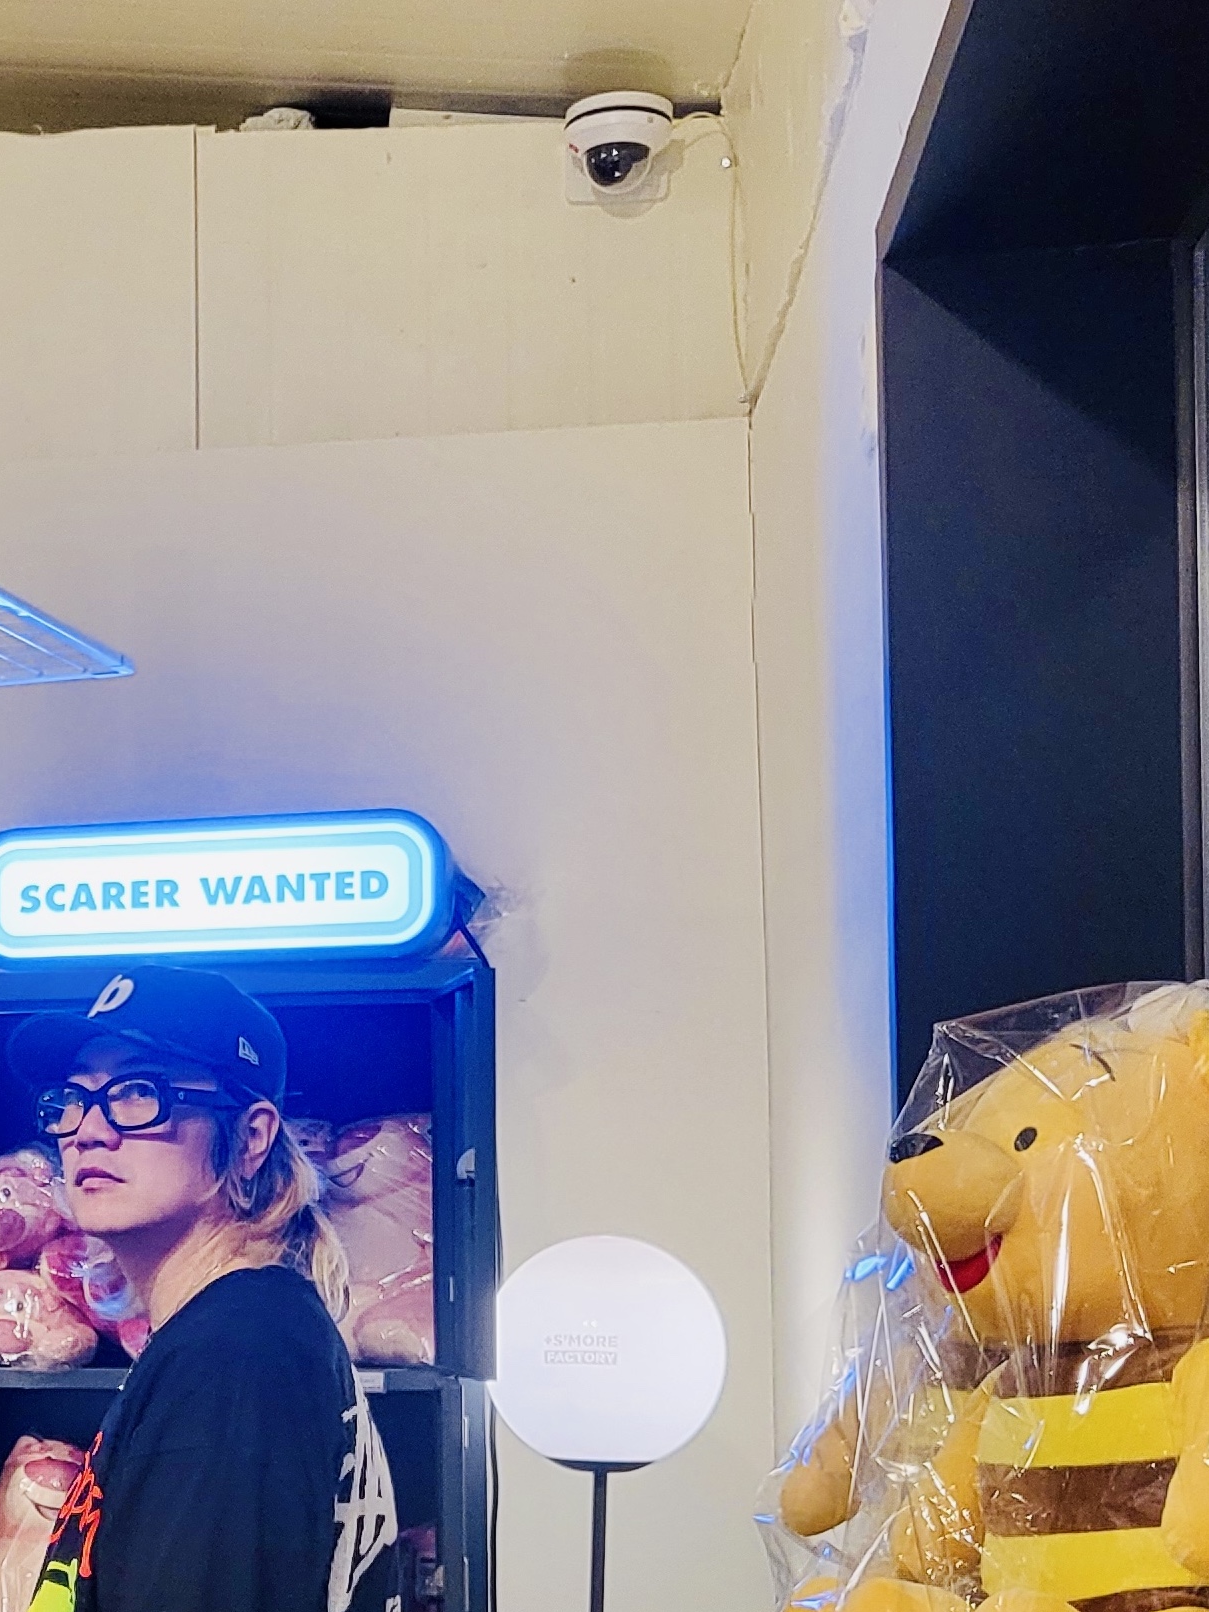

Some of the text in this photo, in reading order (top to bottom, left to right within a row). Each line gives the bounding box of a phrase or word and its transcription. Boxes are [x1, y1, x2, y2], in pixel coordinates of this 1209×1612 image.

[20, 870, 389, 914] SCARER WANTED
[546, 1351, 616, 1363] FACTORY
